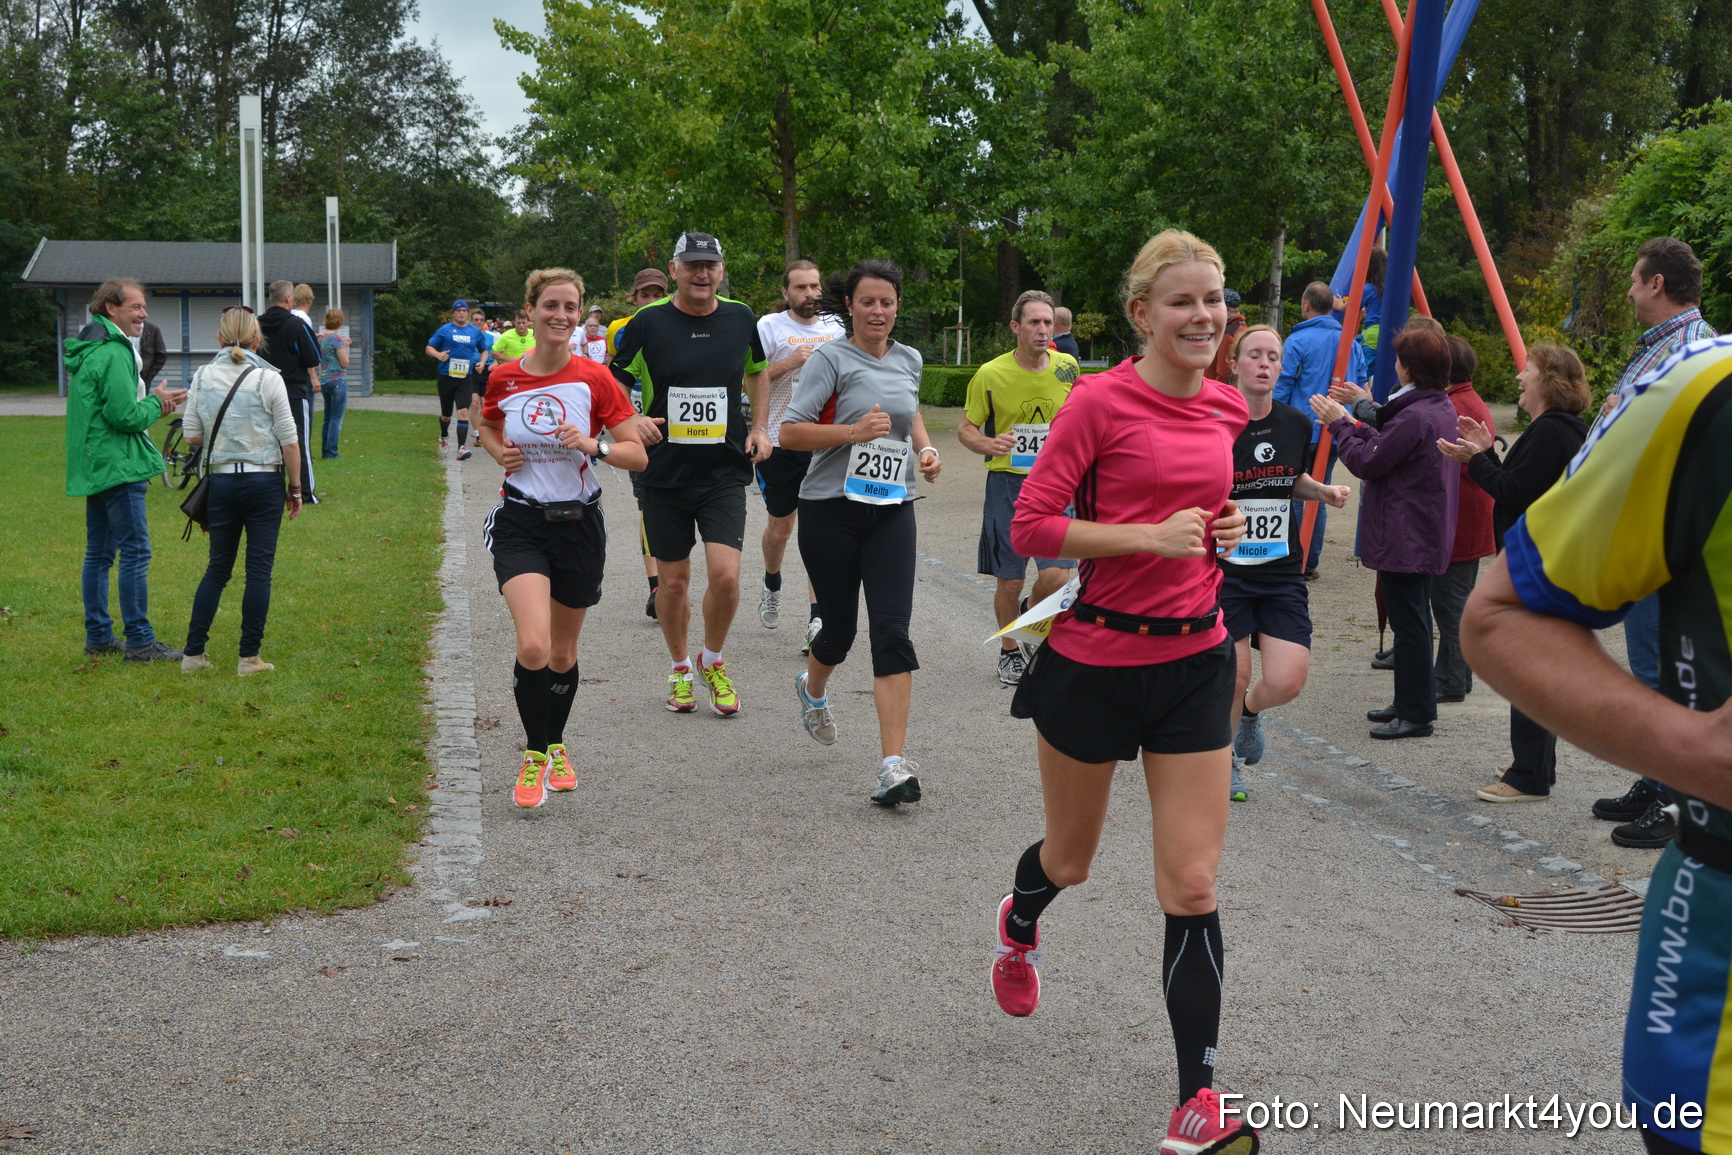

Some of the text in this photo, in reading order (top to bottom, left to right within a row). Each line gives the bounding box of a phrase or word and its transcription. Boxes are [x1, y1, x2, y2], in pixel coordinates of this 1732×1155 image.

[453, 363, 466, 371] 311
[679, 401, 717, 422] 296
[687, 428, 708, 436] Horst
[877, 444, 901, 454] Neumarkt
[855, 451, 903, 481] 2397
[865, 484, 889, 496] Meitta
[1238, 545, 1268, 555] Nicole
